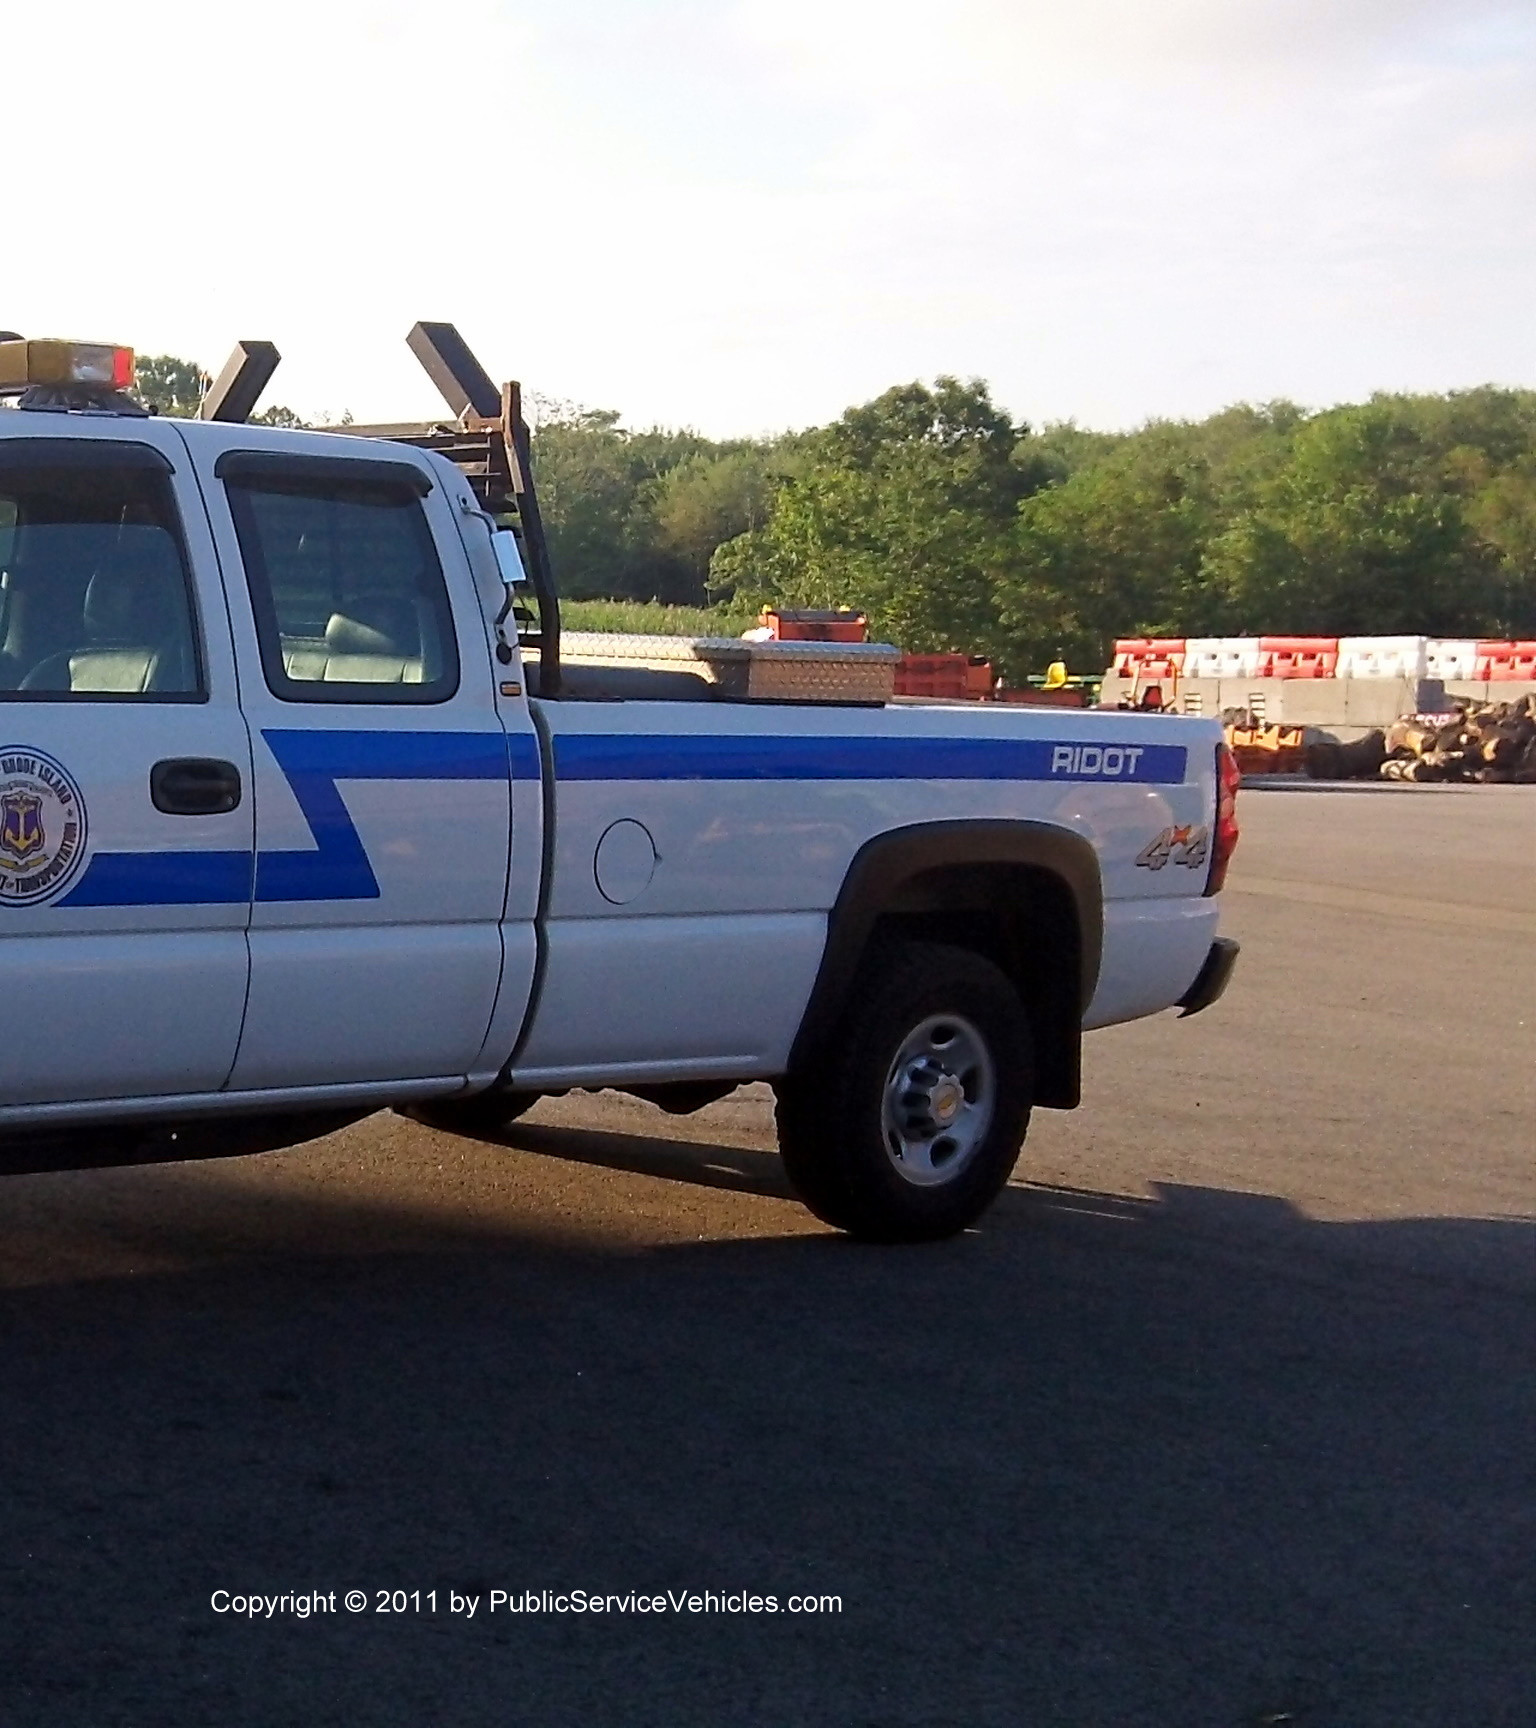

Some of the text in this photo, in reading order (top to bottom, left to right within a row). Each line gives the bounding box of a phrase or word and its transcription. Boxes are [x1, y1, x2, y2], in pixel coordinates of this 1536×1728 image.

[1, 756, 36, 775] RHODE
[38, 763, 72, 804] ISLAND
[1051, 746, 1144, 776] RIDOT
